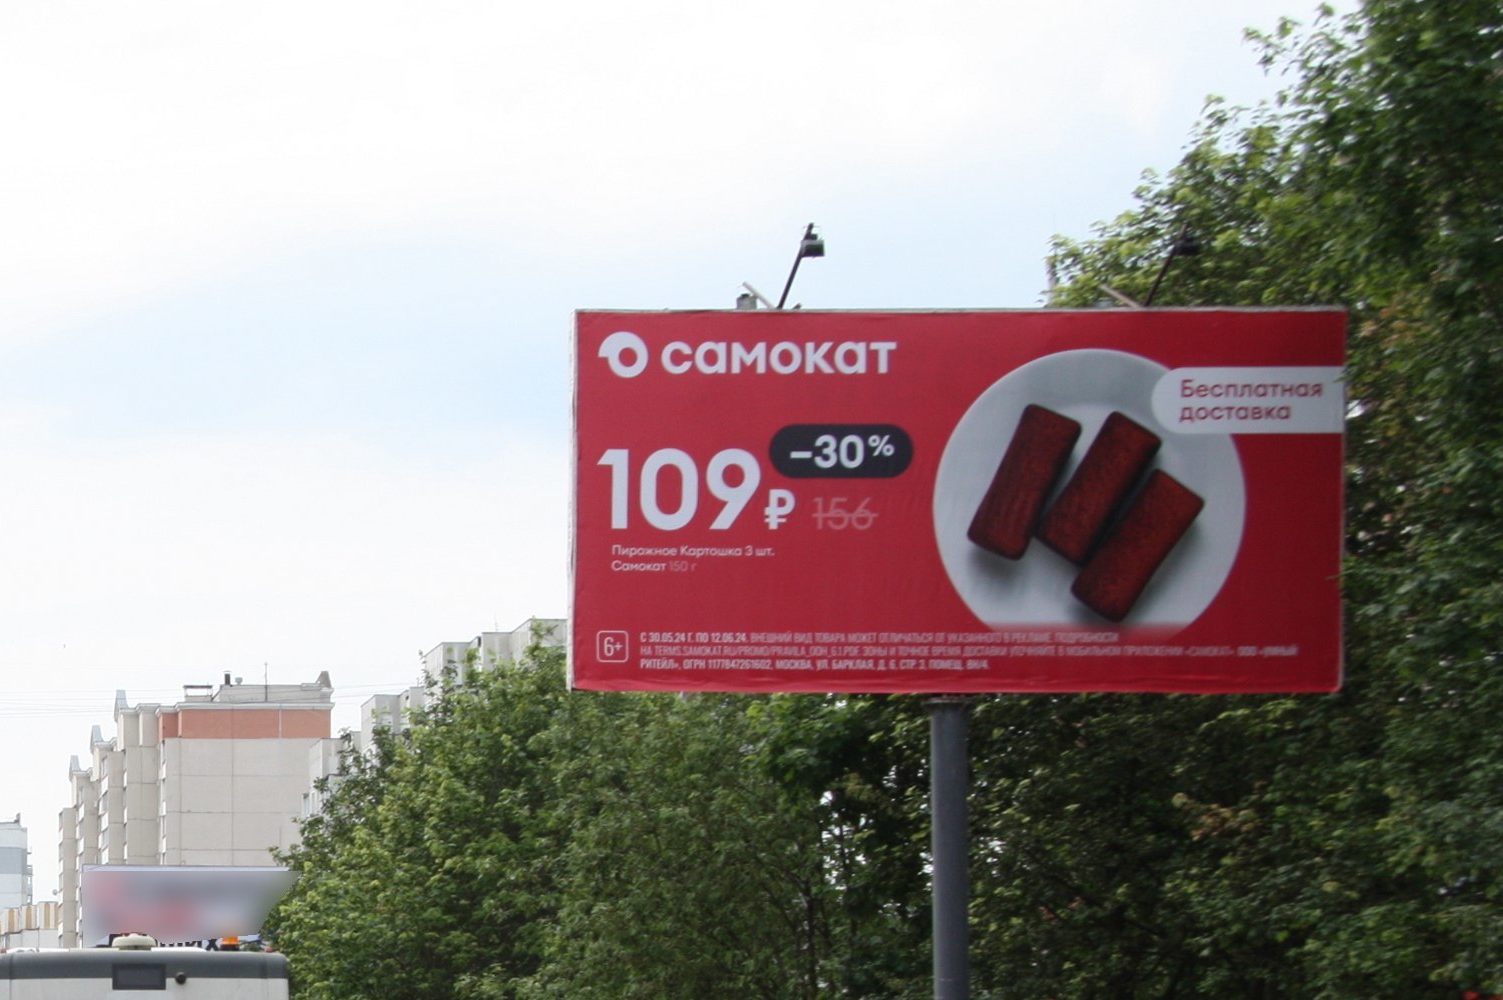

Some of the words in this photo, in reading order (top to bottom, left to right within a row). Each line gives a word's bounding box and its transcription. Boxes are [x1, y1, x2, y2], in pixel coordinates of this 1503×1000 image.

[660, 340, 897, 375] самокат
[1180, 379, 1323, 399] Бесплатная
[1179, 403, 1292, 424] доставка
[812, 496, 878, 530] 156
[611, 544, 678, 557] Пирожное
[679, 544, 742, 557] Картошка
[745, 545, 753, 556] 3
[755, 547, 775, 556] шт.
[611, 560, 667, 572] Самокат
[669, 561, 688, 572] 150
[603, 636, 623, 656] 6+
[648, 632, 686, 643] 30.05.24
[696, 632, 709, 643] ПО
